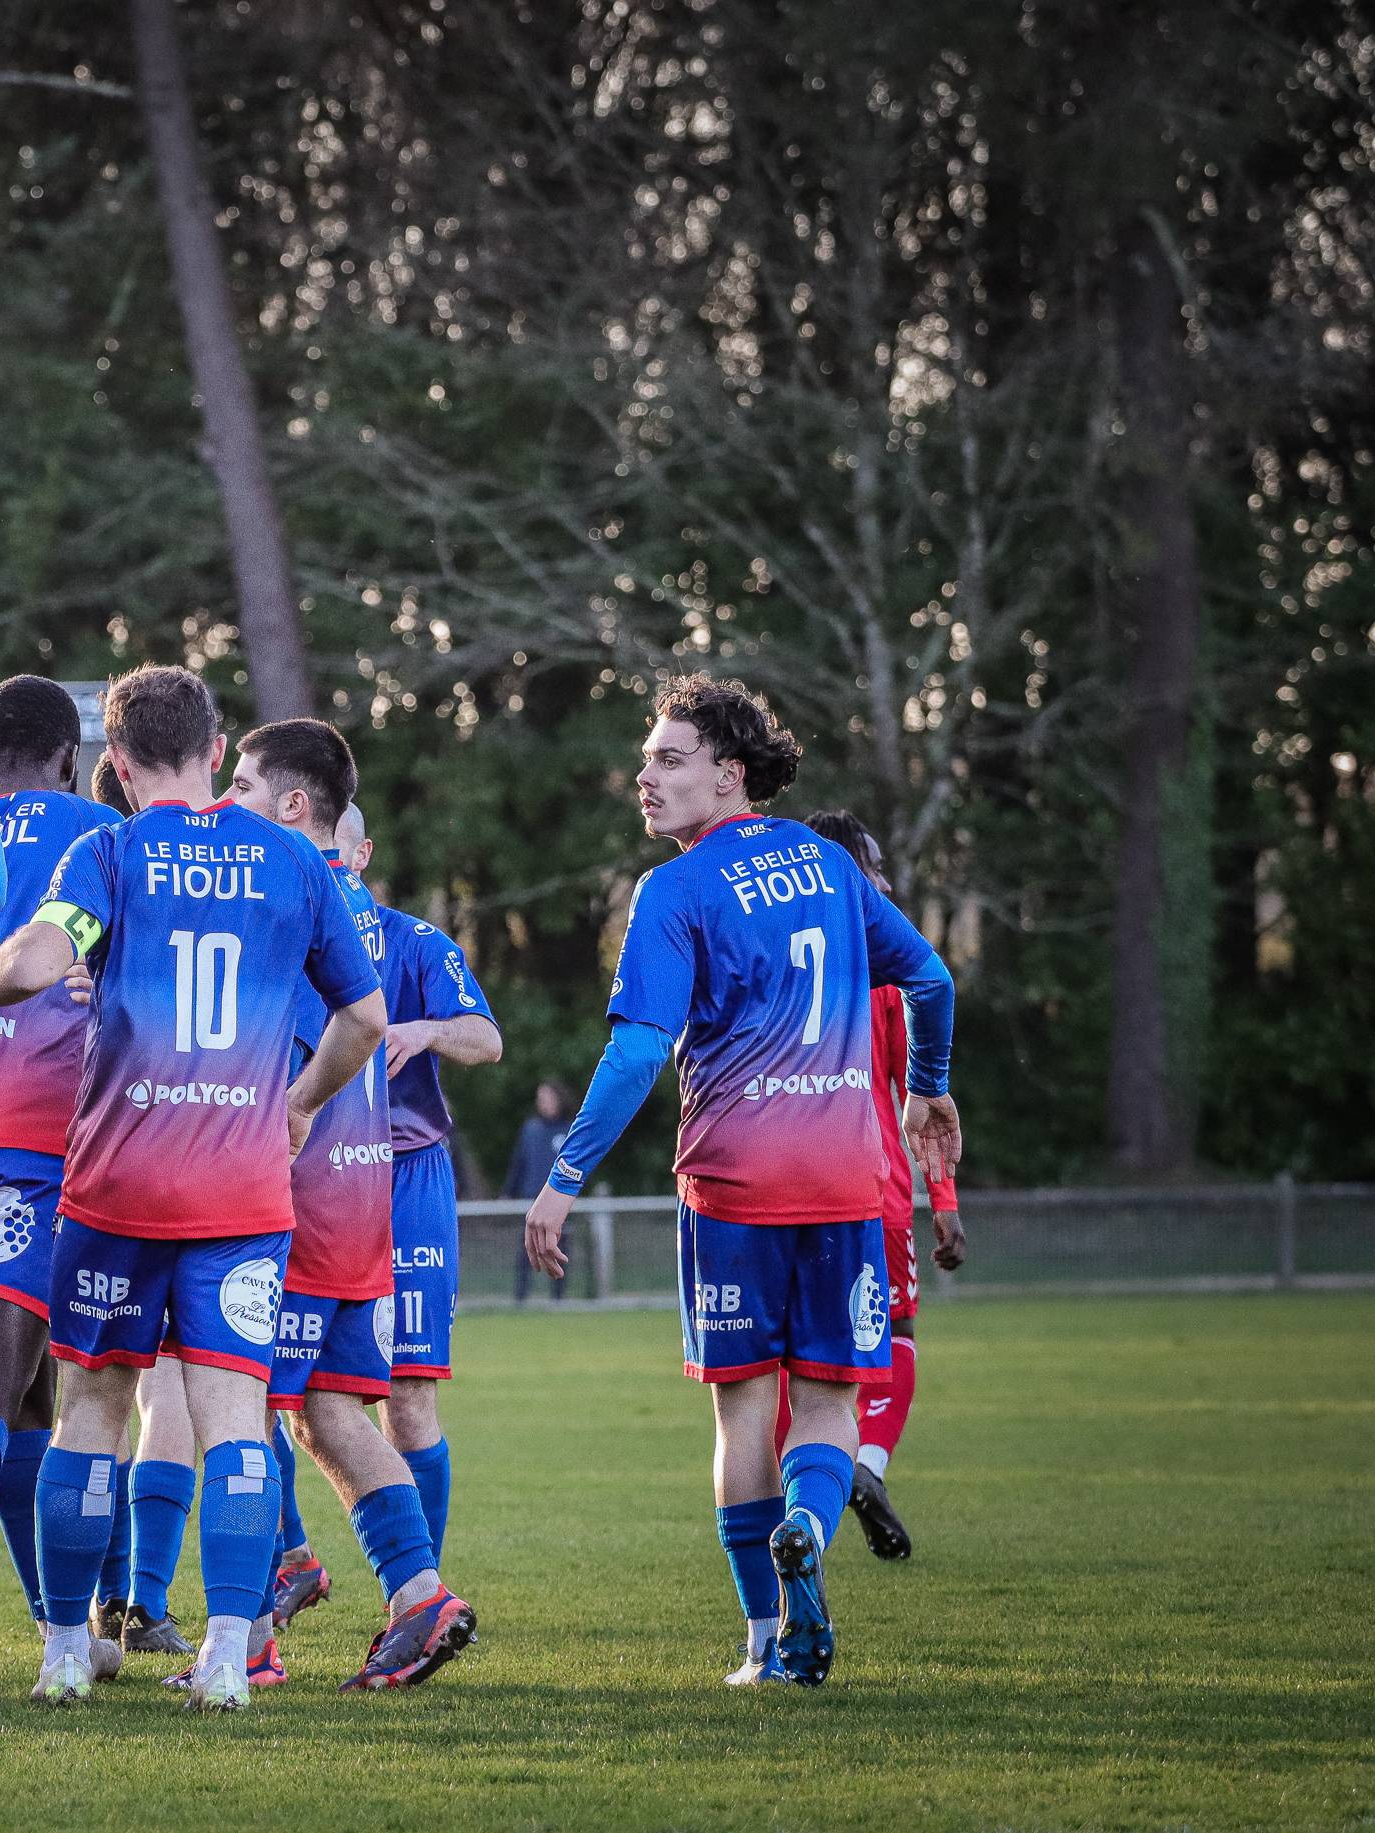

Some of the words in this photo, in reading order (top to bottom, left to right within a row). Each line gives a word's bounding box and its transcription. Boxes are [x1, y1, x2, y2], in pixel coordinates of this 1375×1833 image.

[144, 842, 172, 859] LE
[179, 844, 265, 863] BELLER
[720, 860, 750, 883] LE
[751, 843, 822, 872] BELLER
[147, 861, 265, 900] FIOUL
[732, 863, 835, 915] FIOUL
[168, 930, 242, 1053] 10
[789, 926, 826, 1045] 7
[765, 1067, 871, 1096] POLYGON
[77, 1269, 131, 1304] SRB
[242, 1276, 265, 1290] CAVE
[69, 1301, 142, 1321] CONSTRUCTION
[278, 1311, 323, 1341] RB
[401, 1291, 423, 1334] 11
